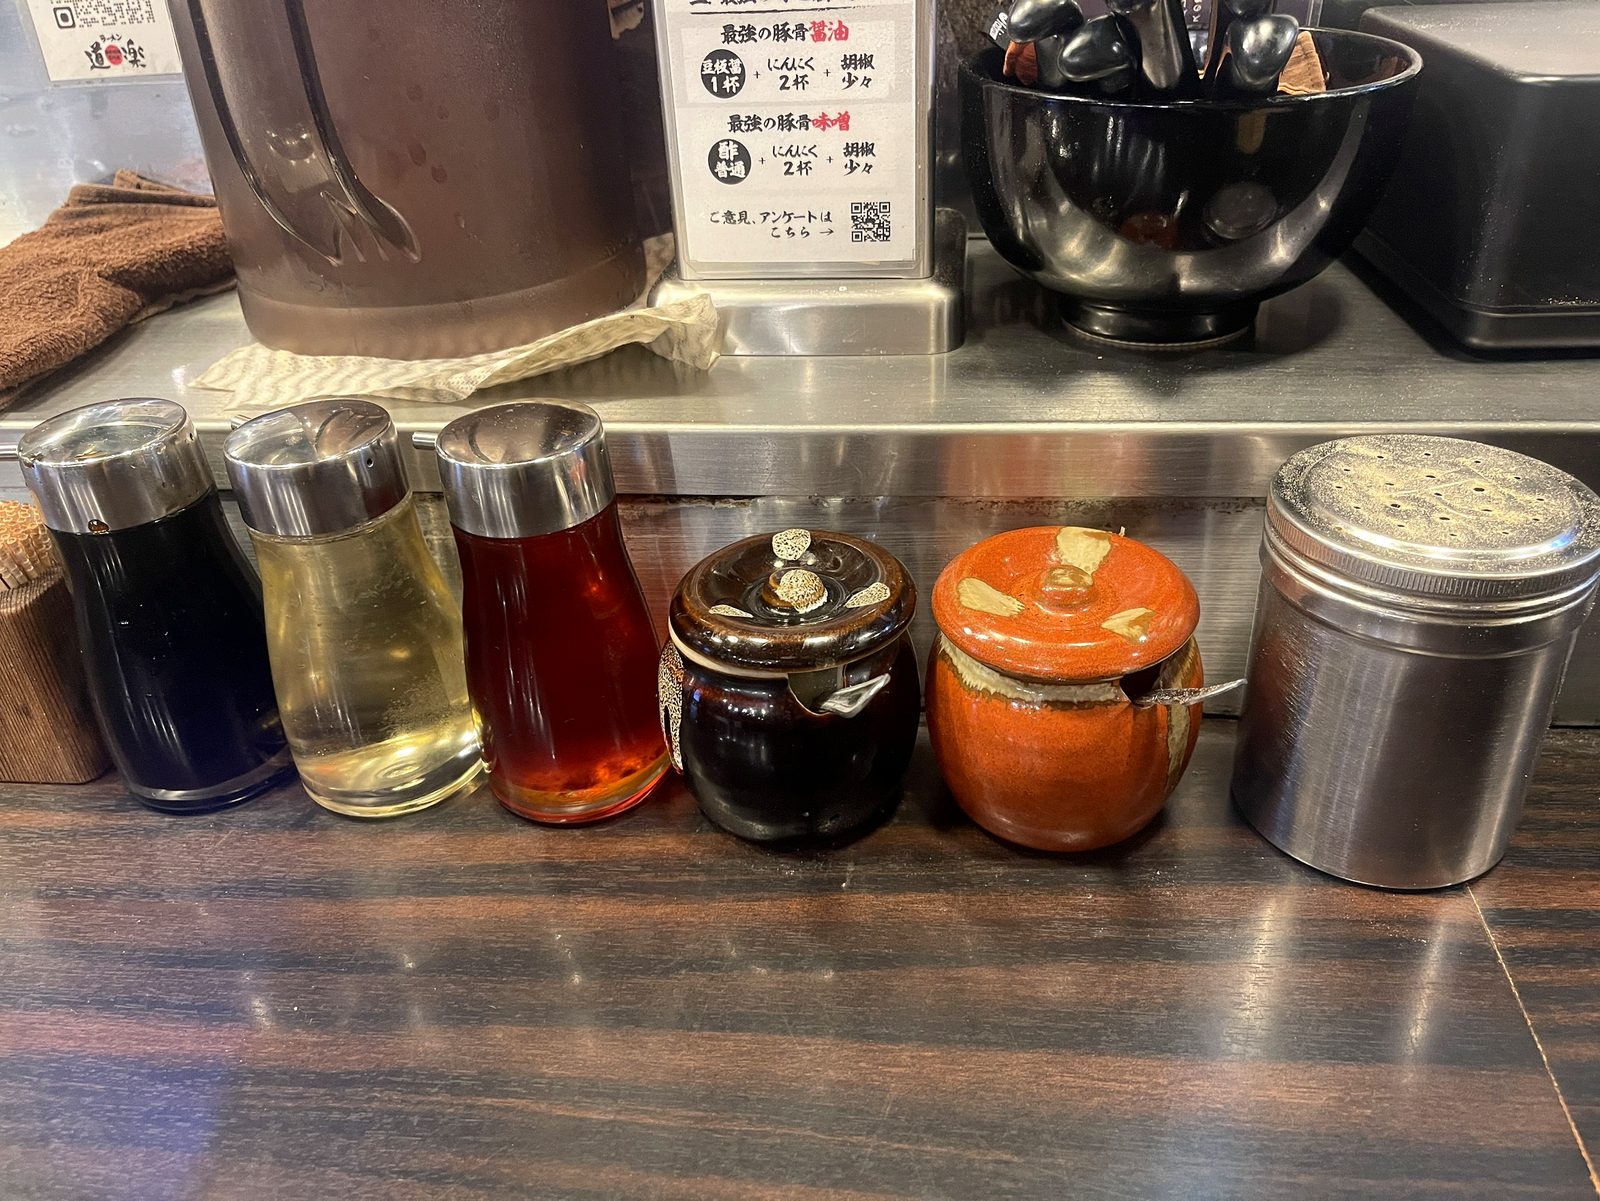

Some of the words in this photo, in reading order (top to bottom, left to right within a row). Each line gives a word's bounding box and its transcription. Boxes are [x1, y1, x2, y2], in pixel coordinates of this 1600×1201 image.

[99, 33, 122, 43] ラーメン
[721, 20, 850, 44] 最強の豚骨醤油
[84, 38, 147, 70] 道楽
[841, 53, 875, 70] 胡椒
[767, 56, 815, 71] にんにく
[711, 76, 740, 93] 1杯
[779, 74, 810, 91] 2杯
[841, 72, 873, 90] 少々
[728, 111, 851, 133] 最強の豚骨味噌
[717, 141, 739, 160] 酢
[772, 145, 818, 158] にんにく
[843, 141, 876, 158] 胡椒
[714, 161, 746, 179] 普通
[783, 161, 813, 176] 2杯
[844, 160, 874, 176] 少々
[709, 210, 833, 225] ご意見、アンケートは
[771, 226, 811, 239] こちら
